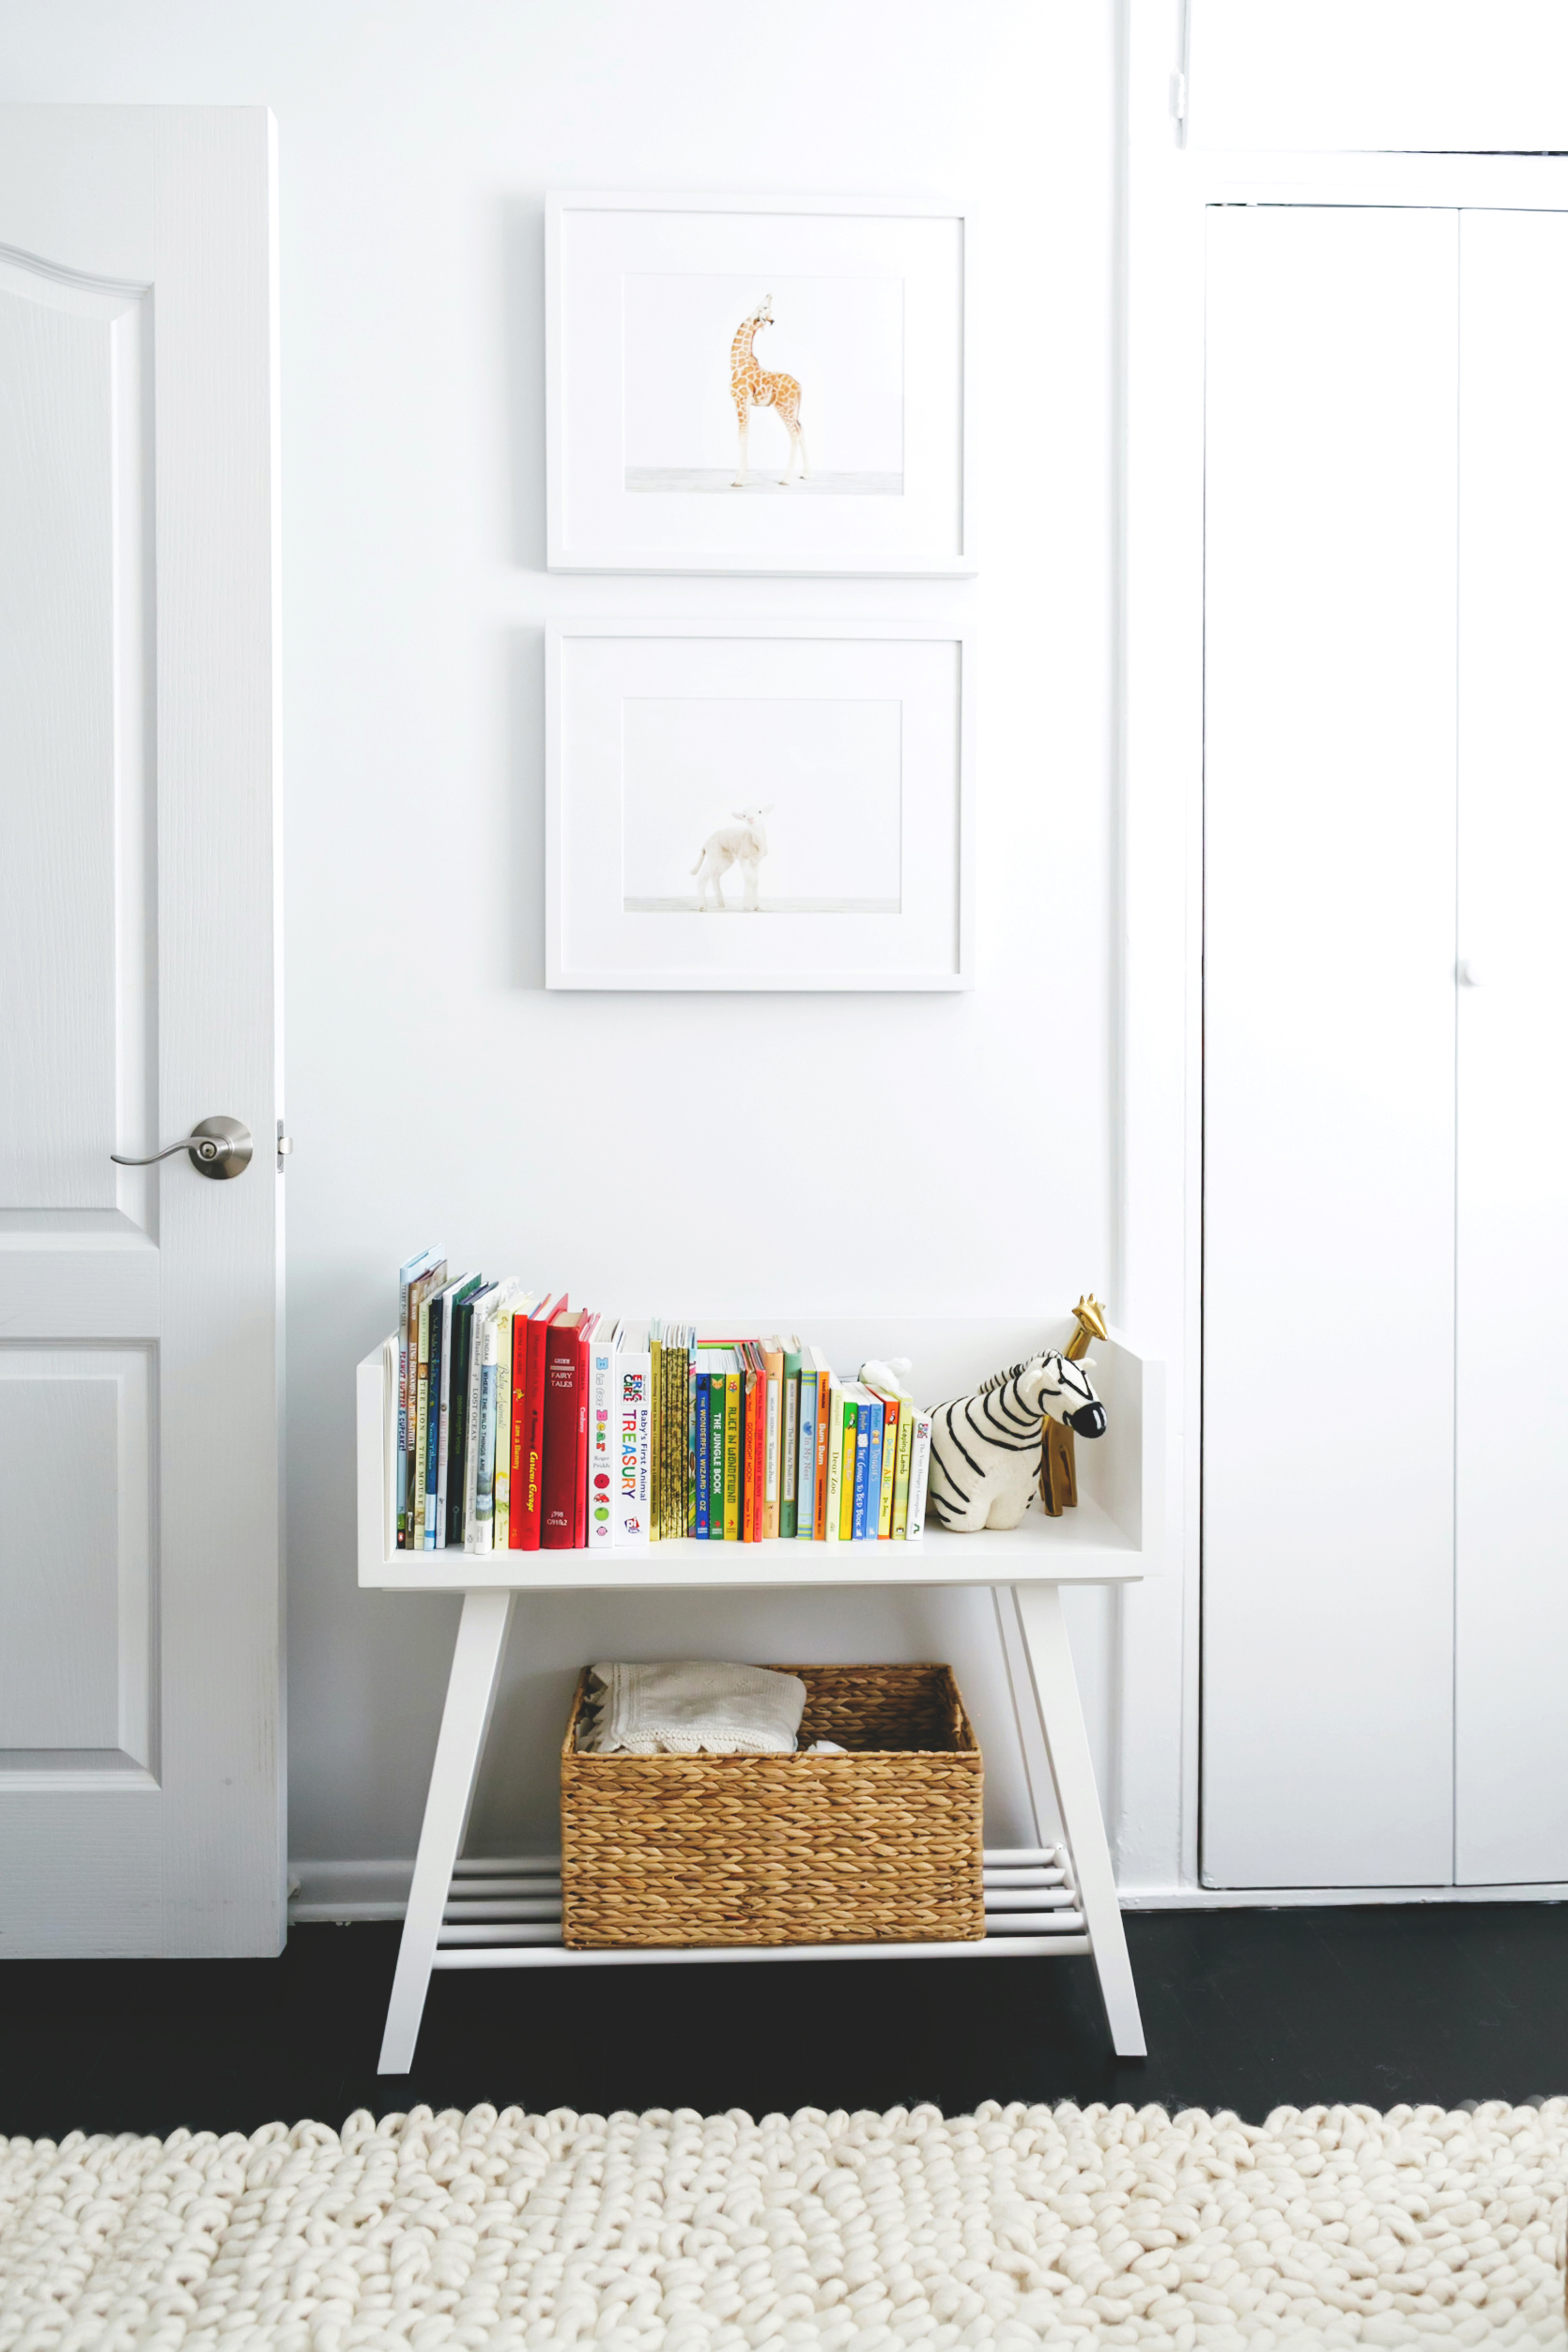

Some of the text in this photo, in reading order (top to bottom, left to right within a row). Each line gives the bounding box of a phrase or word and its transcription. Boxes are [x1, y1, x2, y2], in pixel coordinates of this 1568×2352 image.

[496, 1366, 509, 1429] Baby Animals
[623, 1374, 633, 1402] CARLE
[632, 1374, 643, 1402] ERIC
[596, 1357, 609, 1451] B is for Bear
[515, 1425, 520, 1436] am
[639, 1410, 648, 1440] Baby's
[512, 1445, 521, 1470] Bunny
[622, 1410, 637, 1499] TREASURY
[713, 1413, 722, 1495] THE JUNGLE BOOK
[804, 1448, 811, 1460] My
[858, 1449, 866, 1461] THE
[900, 1423, 911, 1474] Leaping Lamb
[529, 1451, 538, 1483] Curious
[883, 1468, 892, 1489] ABC
[526, 1483, 537, 1512] George
[700, 1500, 706, 1512] OZ
